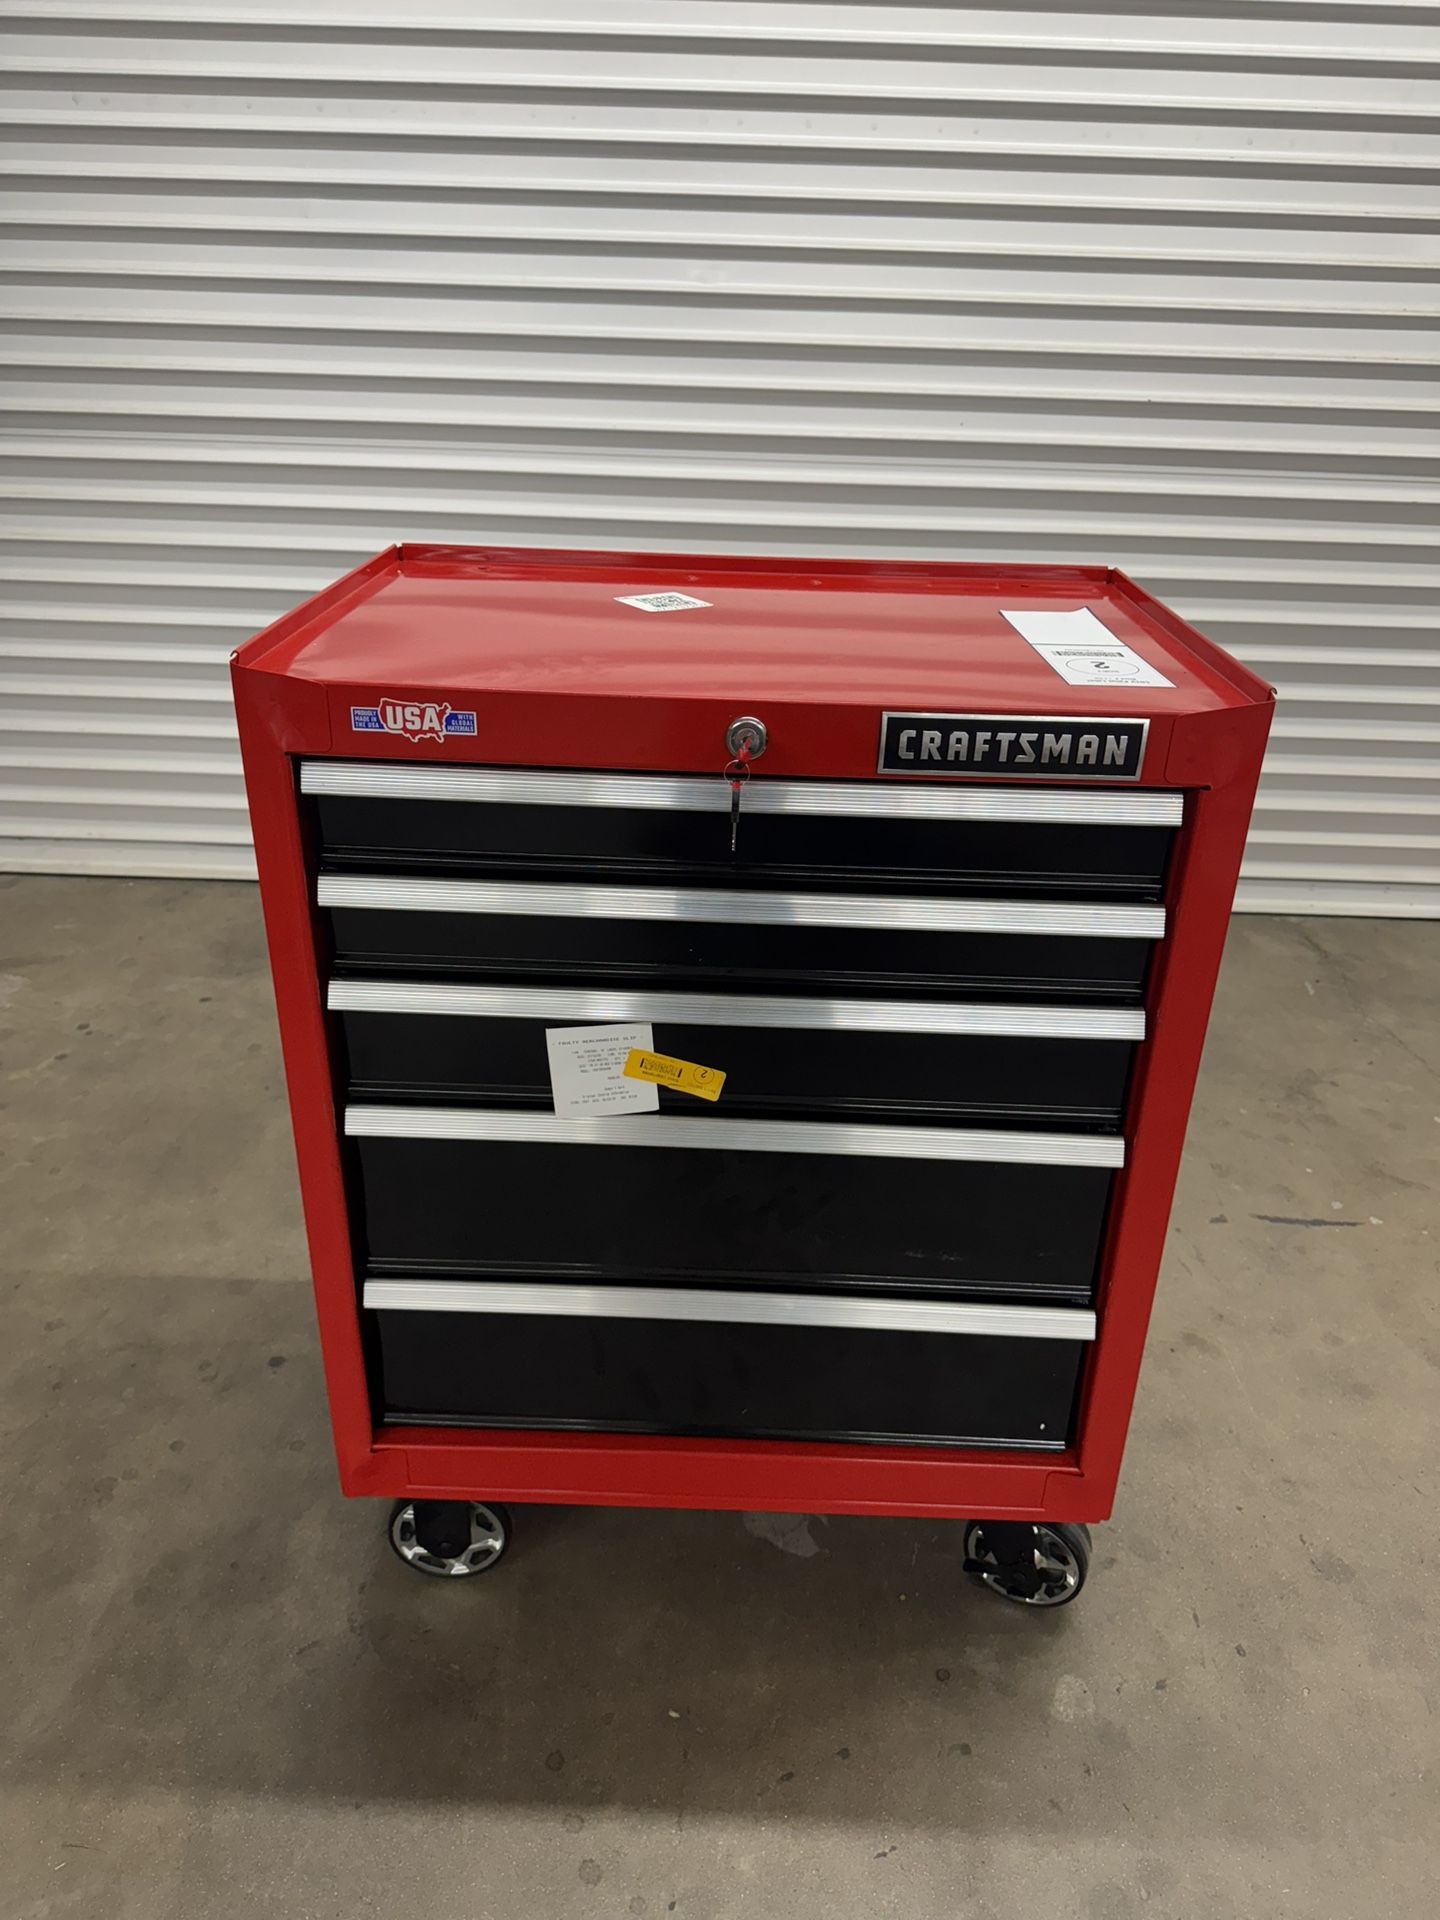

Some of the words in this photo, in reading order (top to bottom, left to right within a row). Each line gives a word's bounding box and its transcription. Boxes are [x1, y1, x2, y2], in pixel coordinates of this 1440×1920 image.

[1090, 661, 1110, 669] 2
[385, 705, 442, 731] USA
[898, 729, 1128, 766] CRAFTSMAN
[700, 1070, 708, 1079] 2
